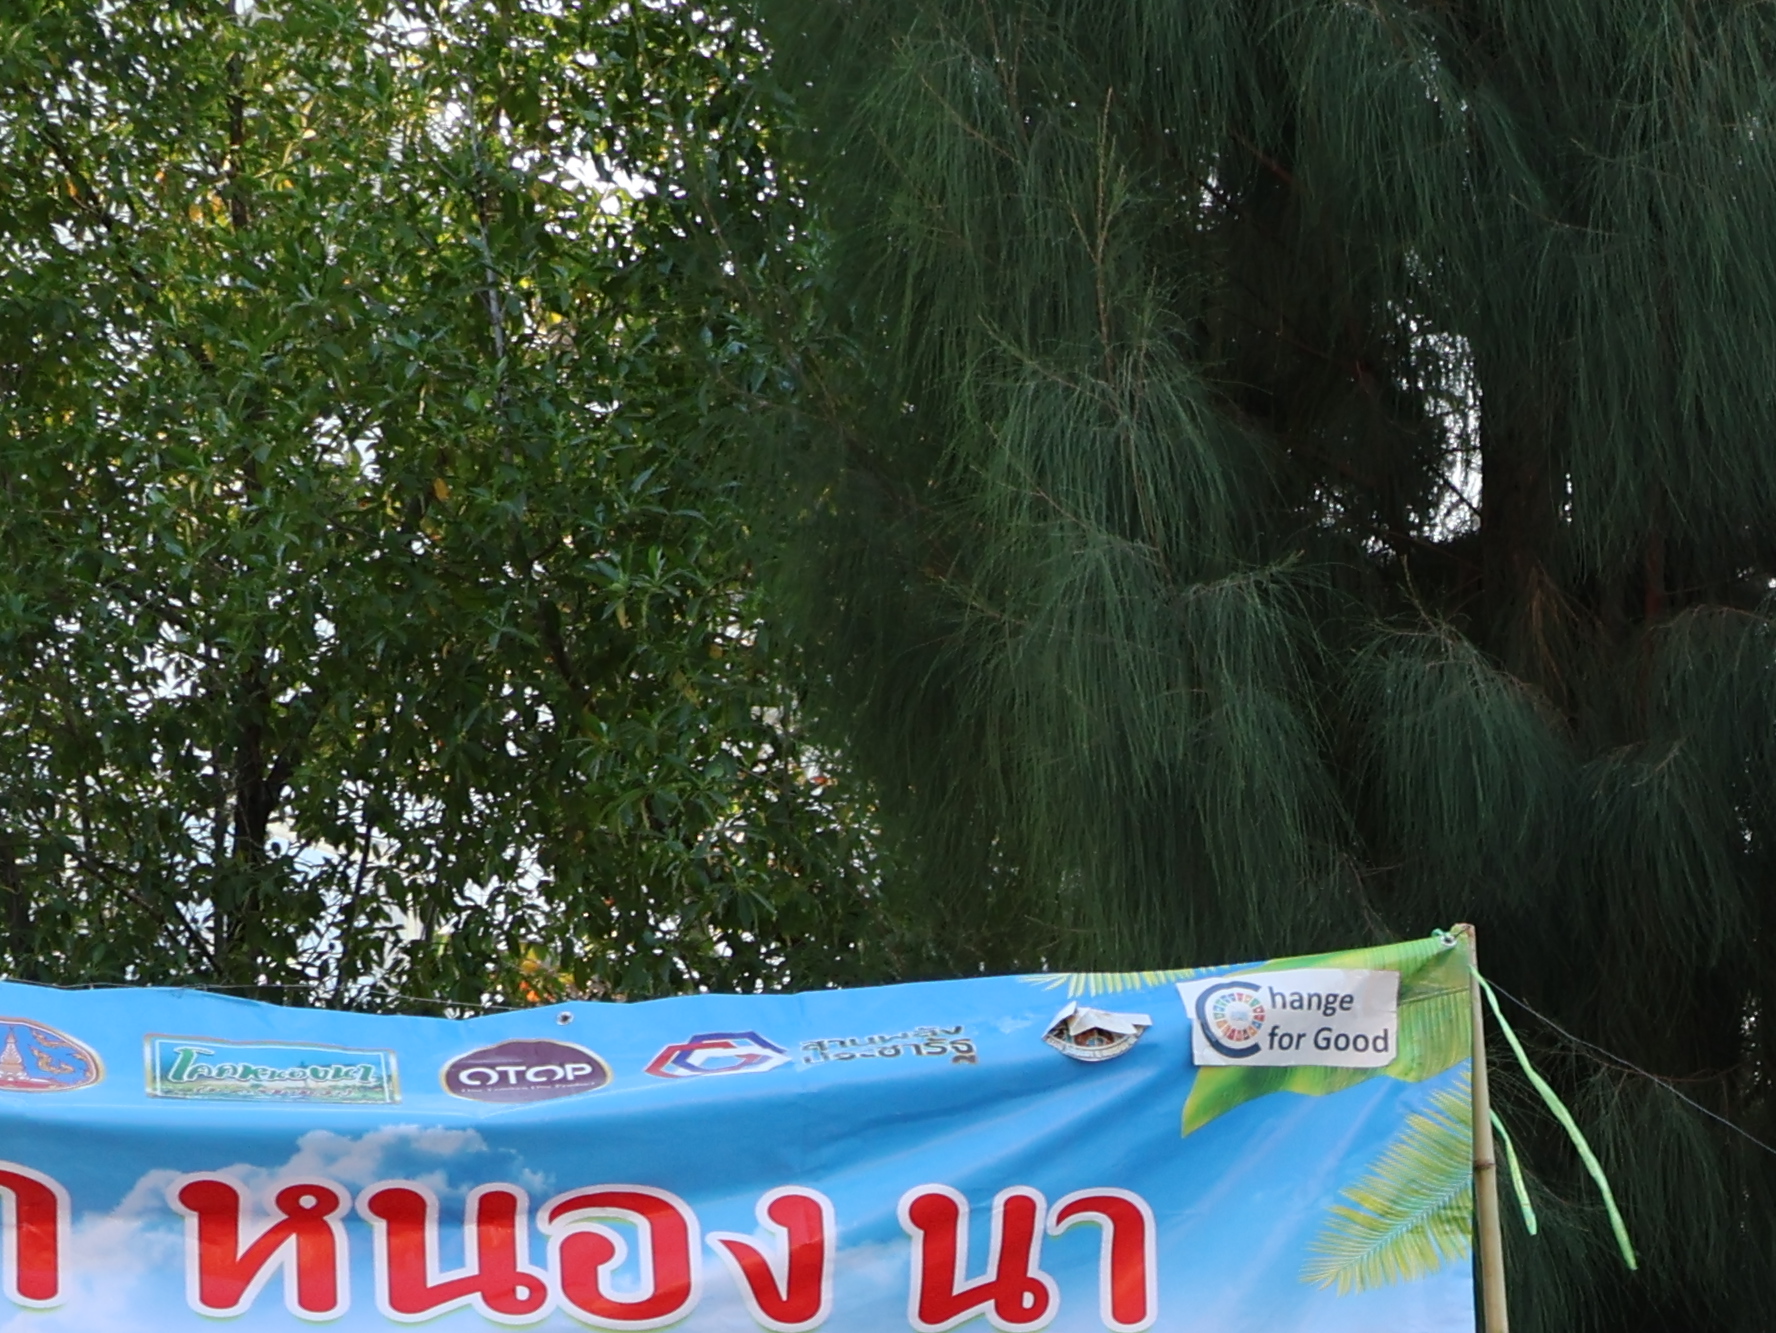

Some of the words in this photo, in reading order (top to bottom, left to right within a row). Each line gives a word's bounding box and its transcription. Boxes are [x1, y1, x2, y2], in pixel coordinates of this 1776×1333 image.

[1269, 1026, 1306, 1050] for
[1314, 1027, 1389, 1052] Good
[459, 1063, 592, 1086] OTOP
[178, 1180, 822, 1324] หนอง
[909, 1193, 1144, 1325] นา
